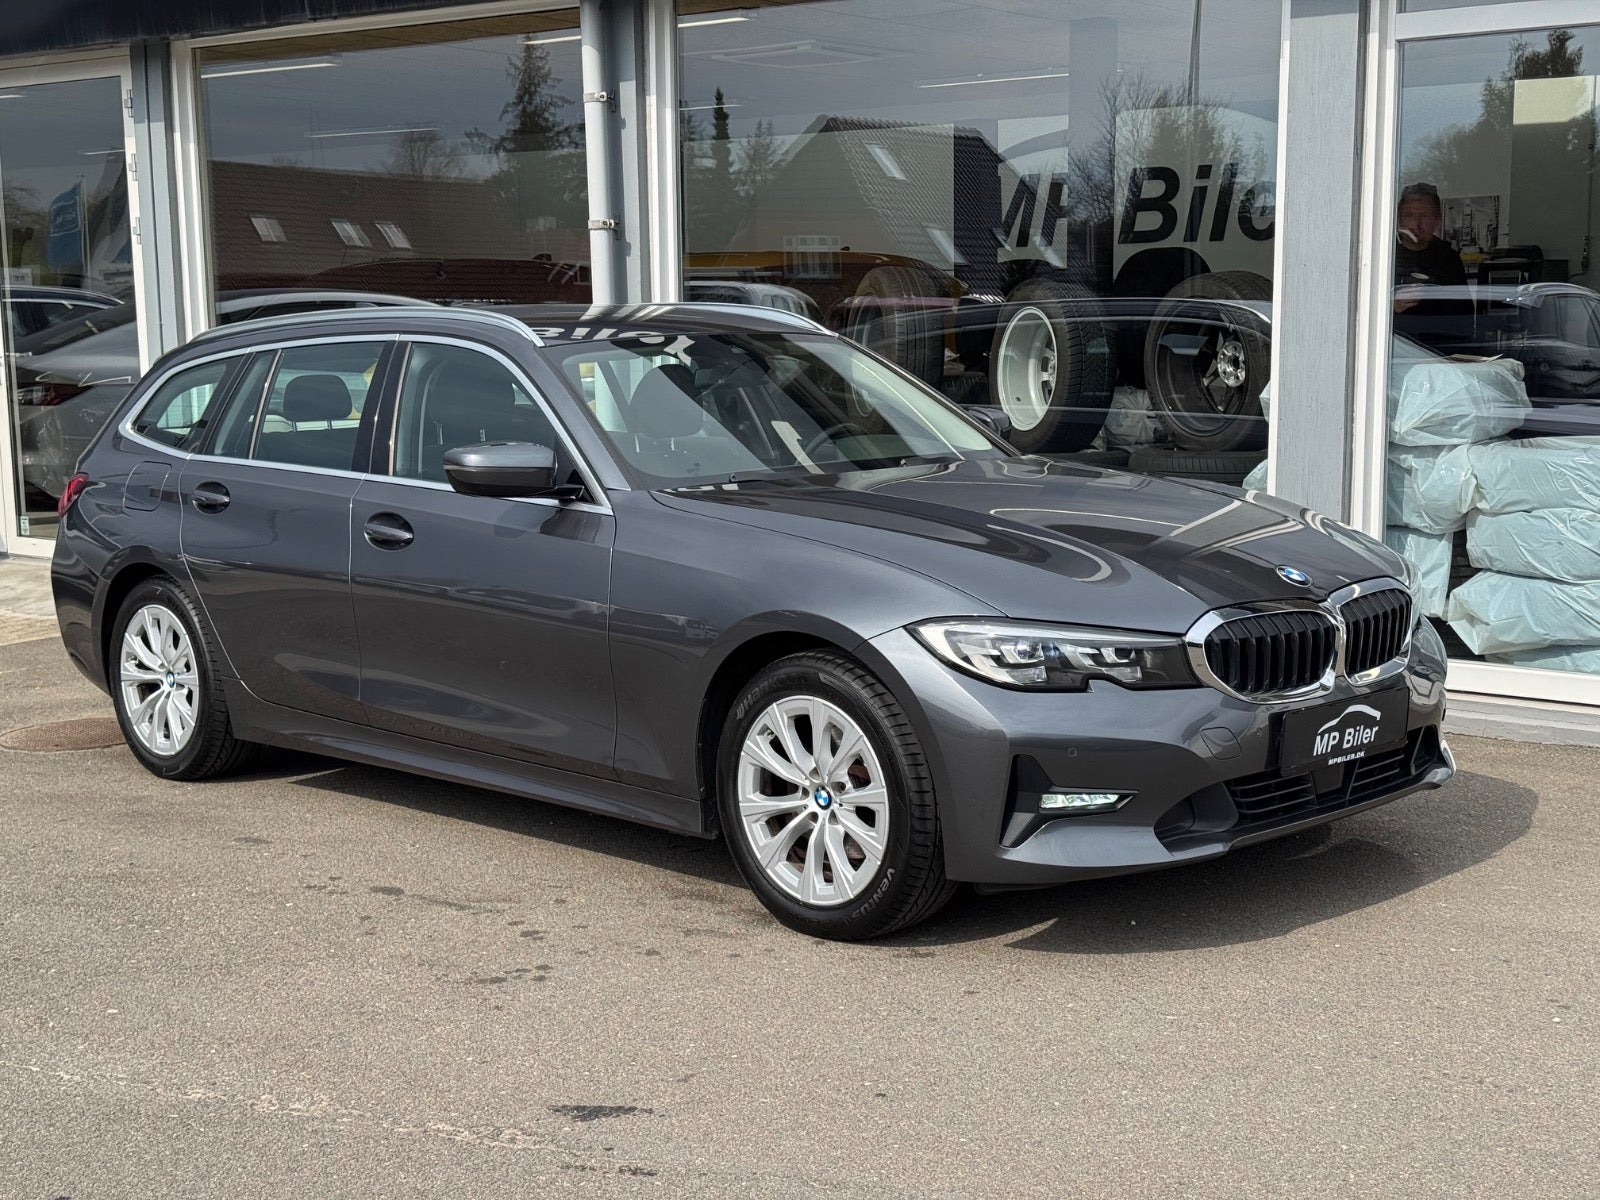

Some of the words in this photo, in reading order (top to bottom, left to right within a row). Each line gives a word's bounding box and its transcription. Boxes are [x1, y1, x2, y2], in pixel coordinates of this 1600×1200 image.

[1313, 732, 1340, 756] MP
[1342, 725, 1379, 749] Biler
[1328, 751, 1366, 765] MPBILER.DK
